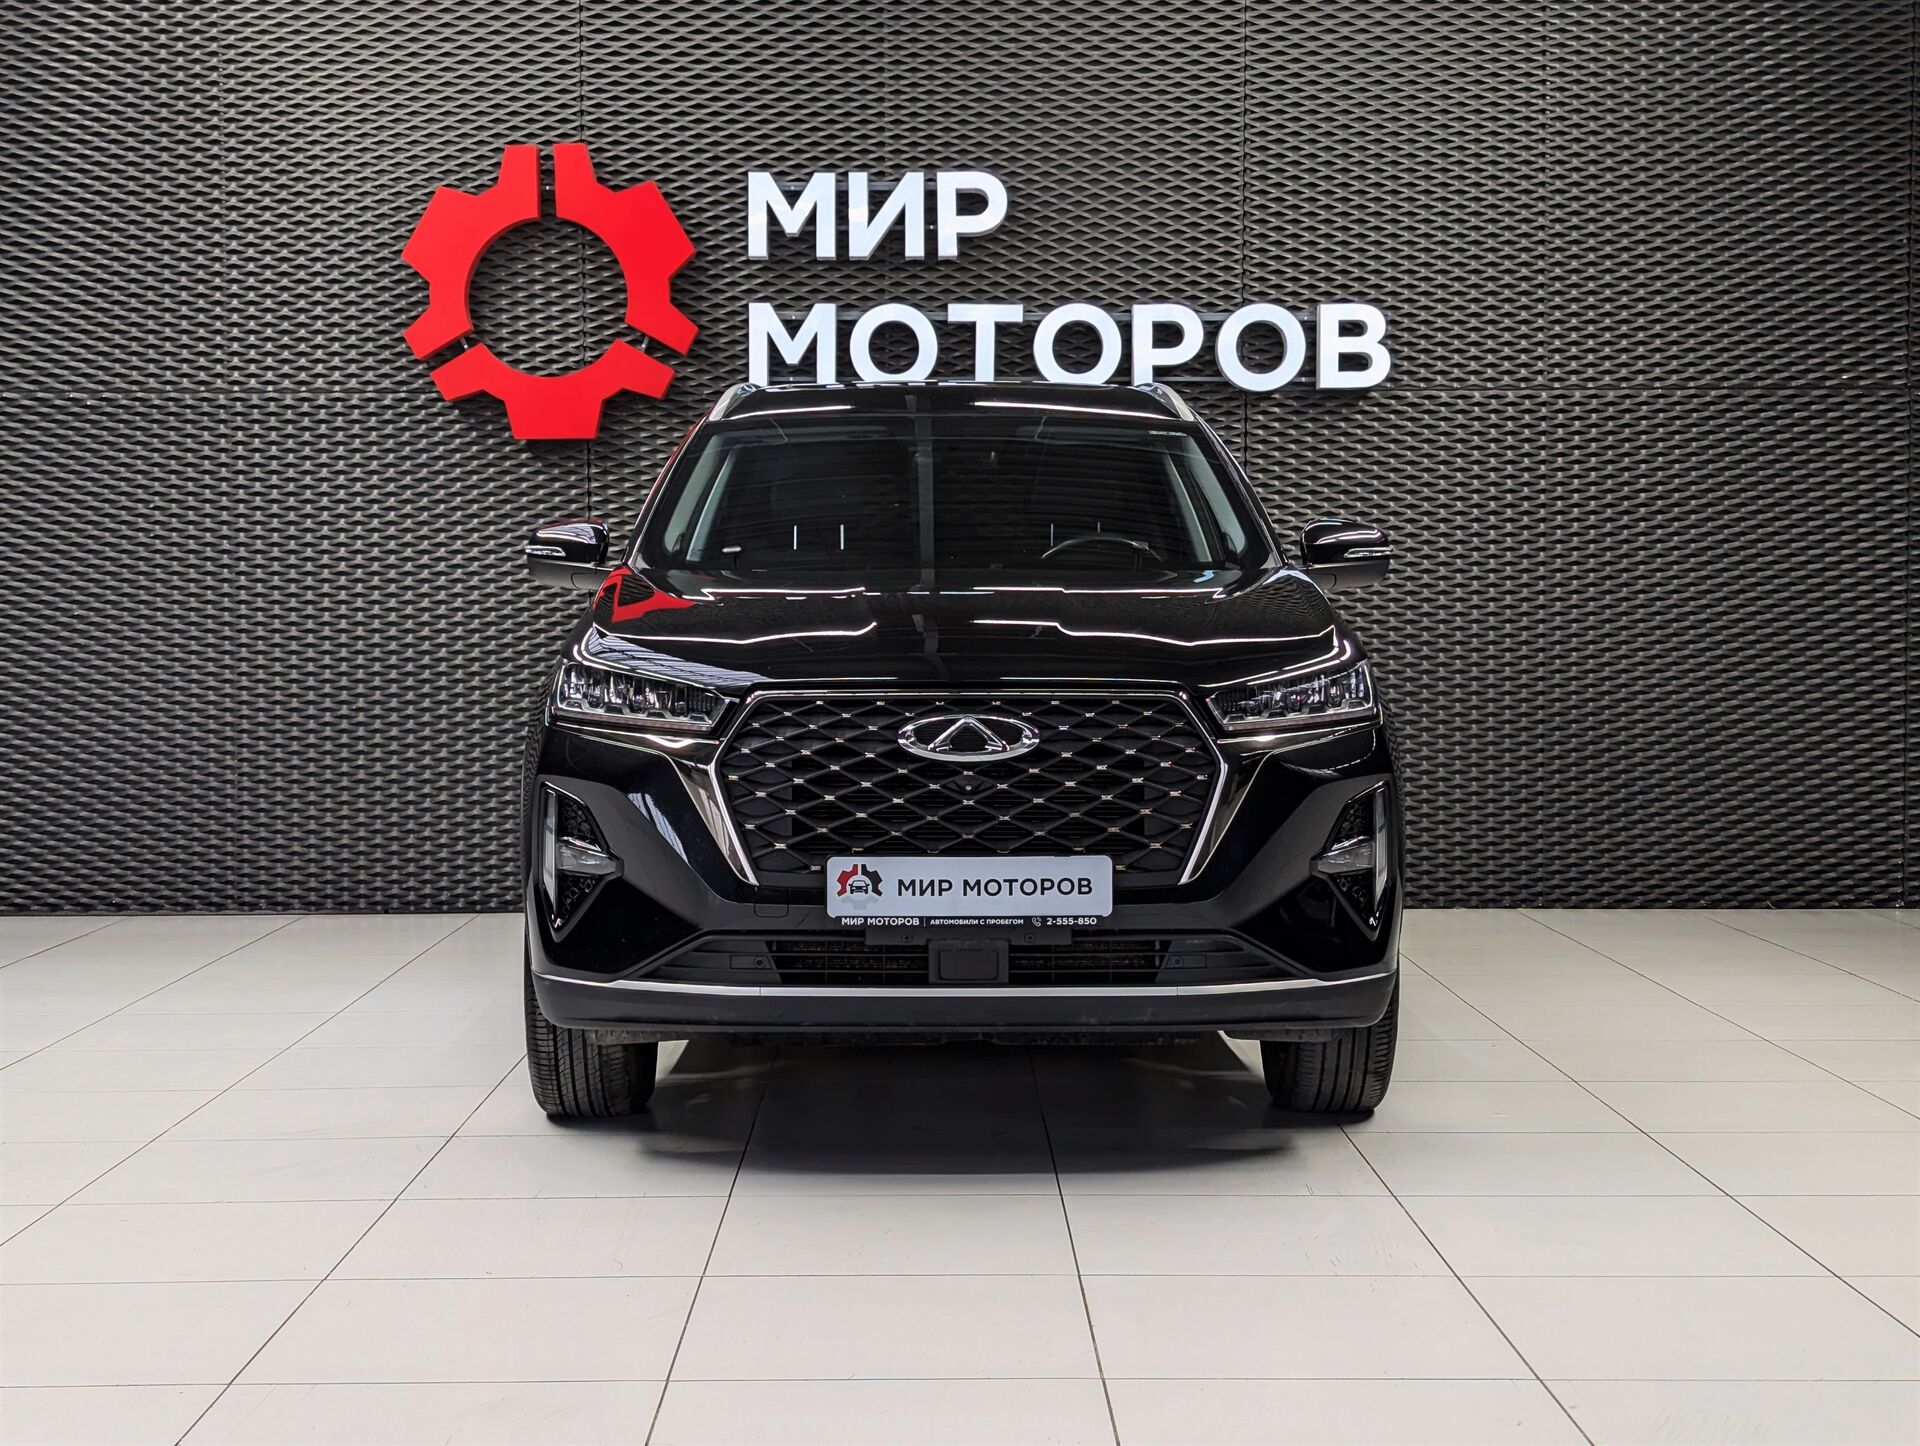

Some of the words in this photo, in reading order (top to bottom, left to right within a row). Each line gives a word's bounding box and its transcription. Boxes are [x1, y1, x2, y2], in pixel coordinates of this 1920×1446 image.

[747, 170, 1009, 261] МИР
[747, 302, 1393, 393] МОТОРОВ
[897, 878, 953, 896] МИР
[962, 877, 1093, 896] МОТОРОВ
[841, 917, 865, 926] МИР
[867, 917, 920, 926] МОТОРОВ
[1046, 917, 1097, 926] 2-555-850
